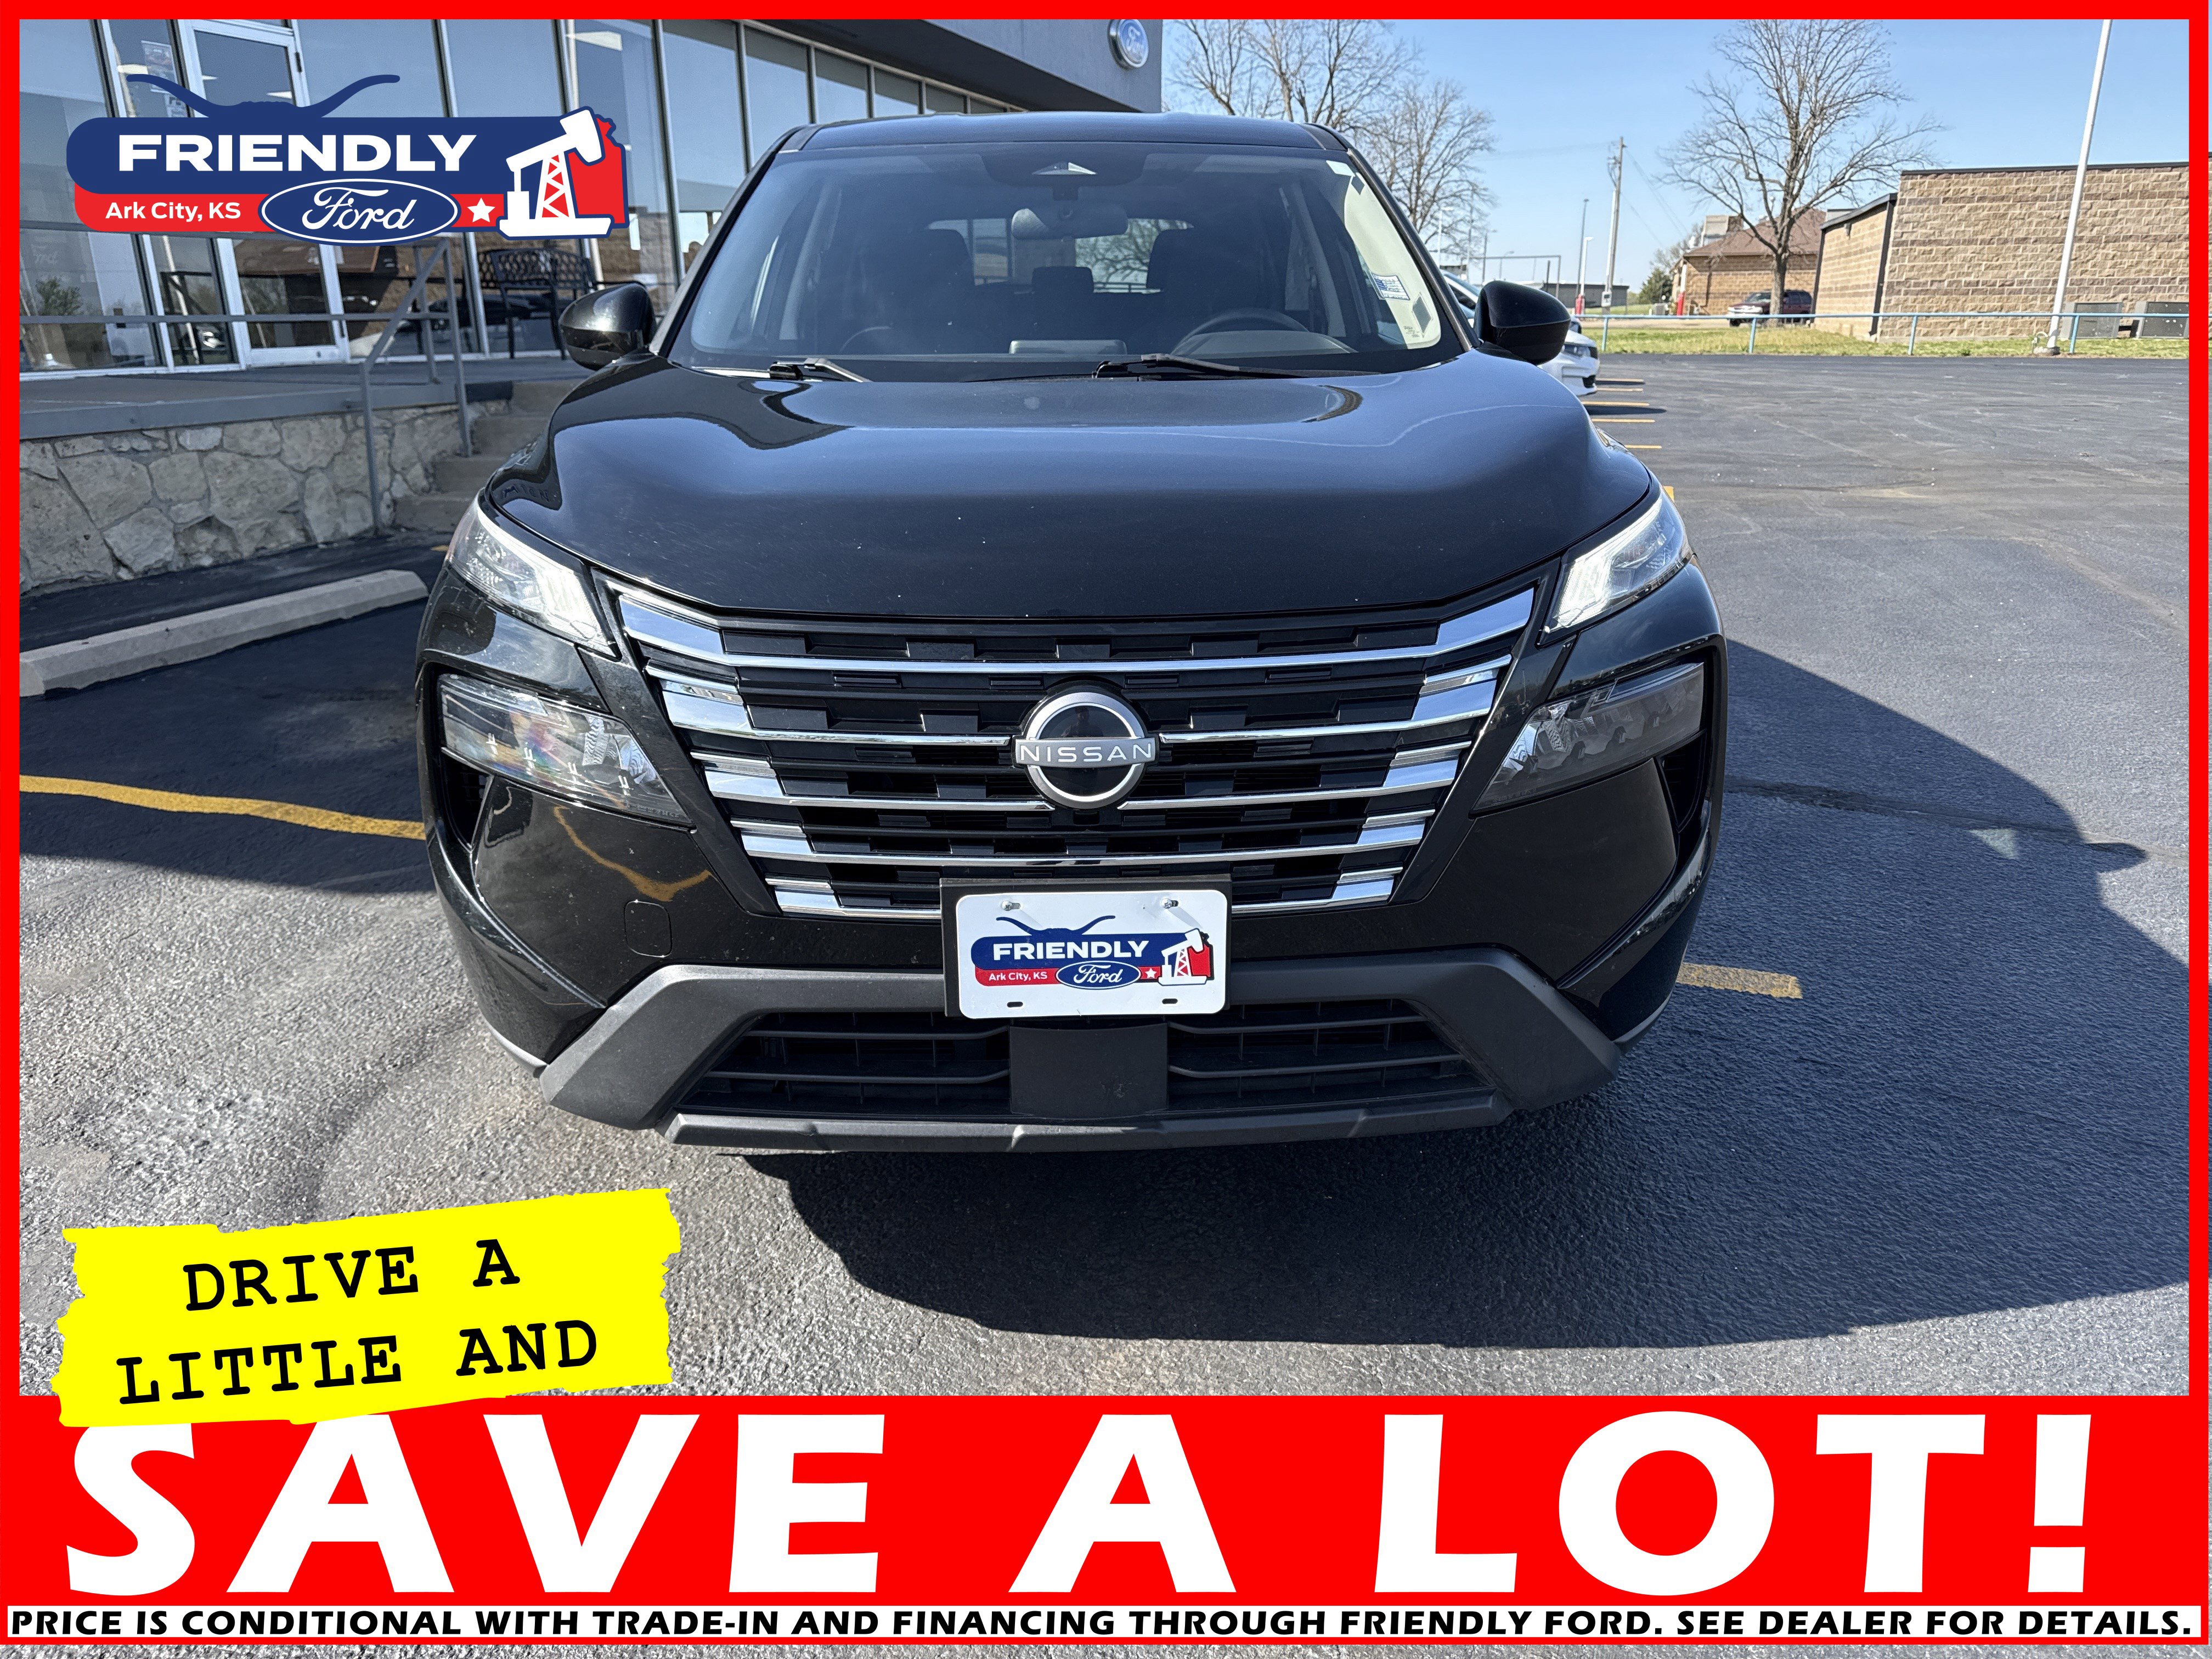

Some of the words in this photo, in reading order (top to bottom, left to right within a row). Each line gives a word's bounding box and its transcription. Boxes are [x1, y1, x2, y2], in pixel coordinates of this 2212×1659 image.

[1020, 743, 1152, 763] NISSAN
[993, 940, 1149, 961] FRIENDLY
[989, 973, 1006, 981] Ark
[1008, 972, 1031, 981] City,
[1034, 971, 1048, 980] KS
[1073, 964, 1123, 984] Ford
